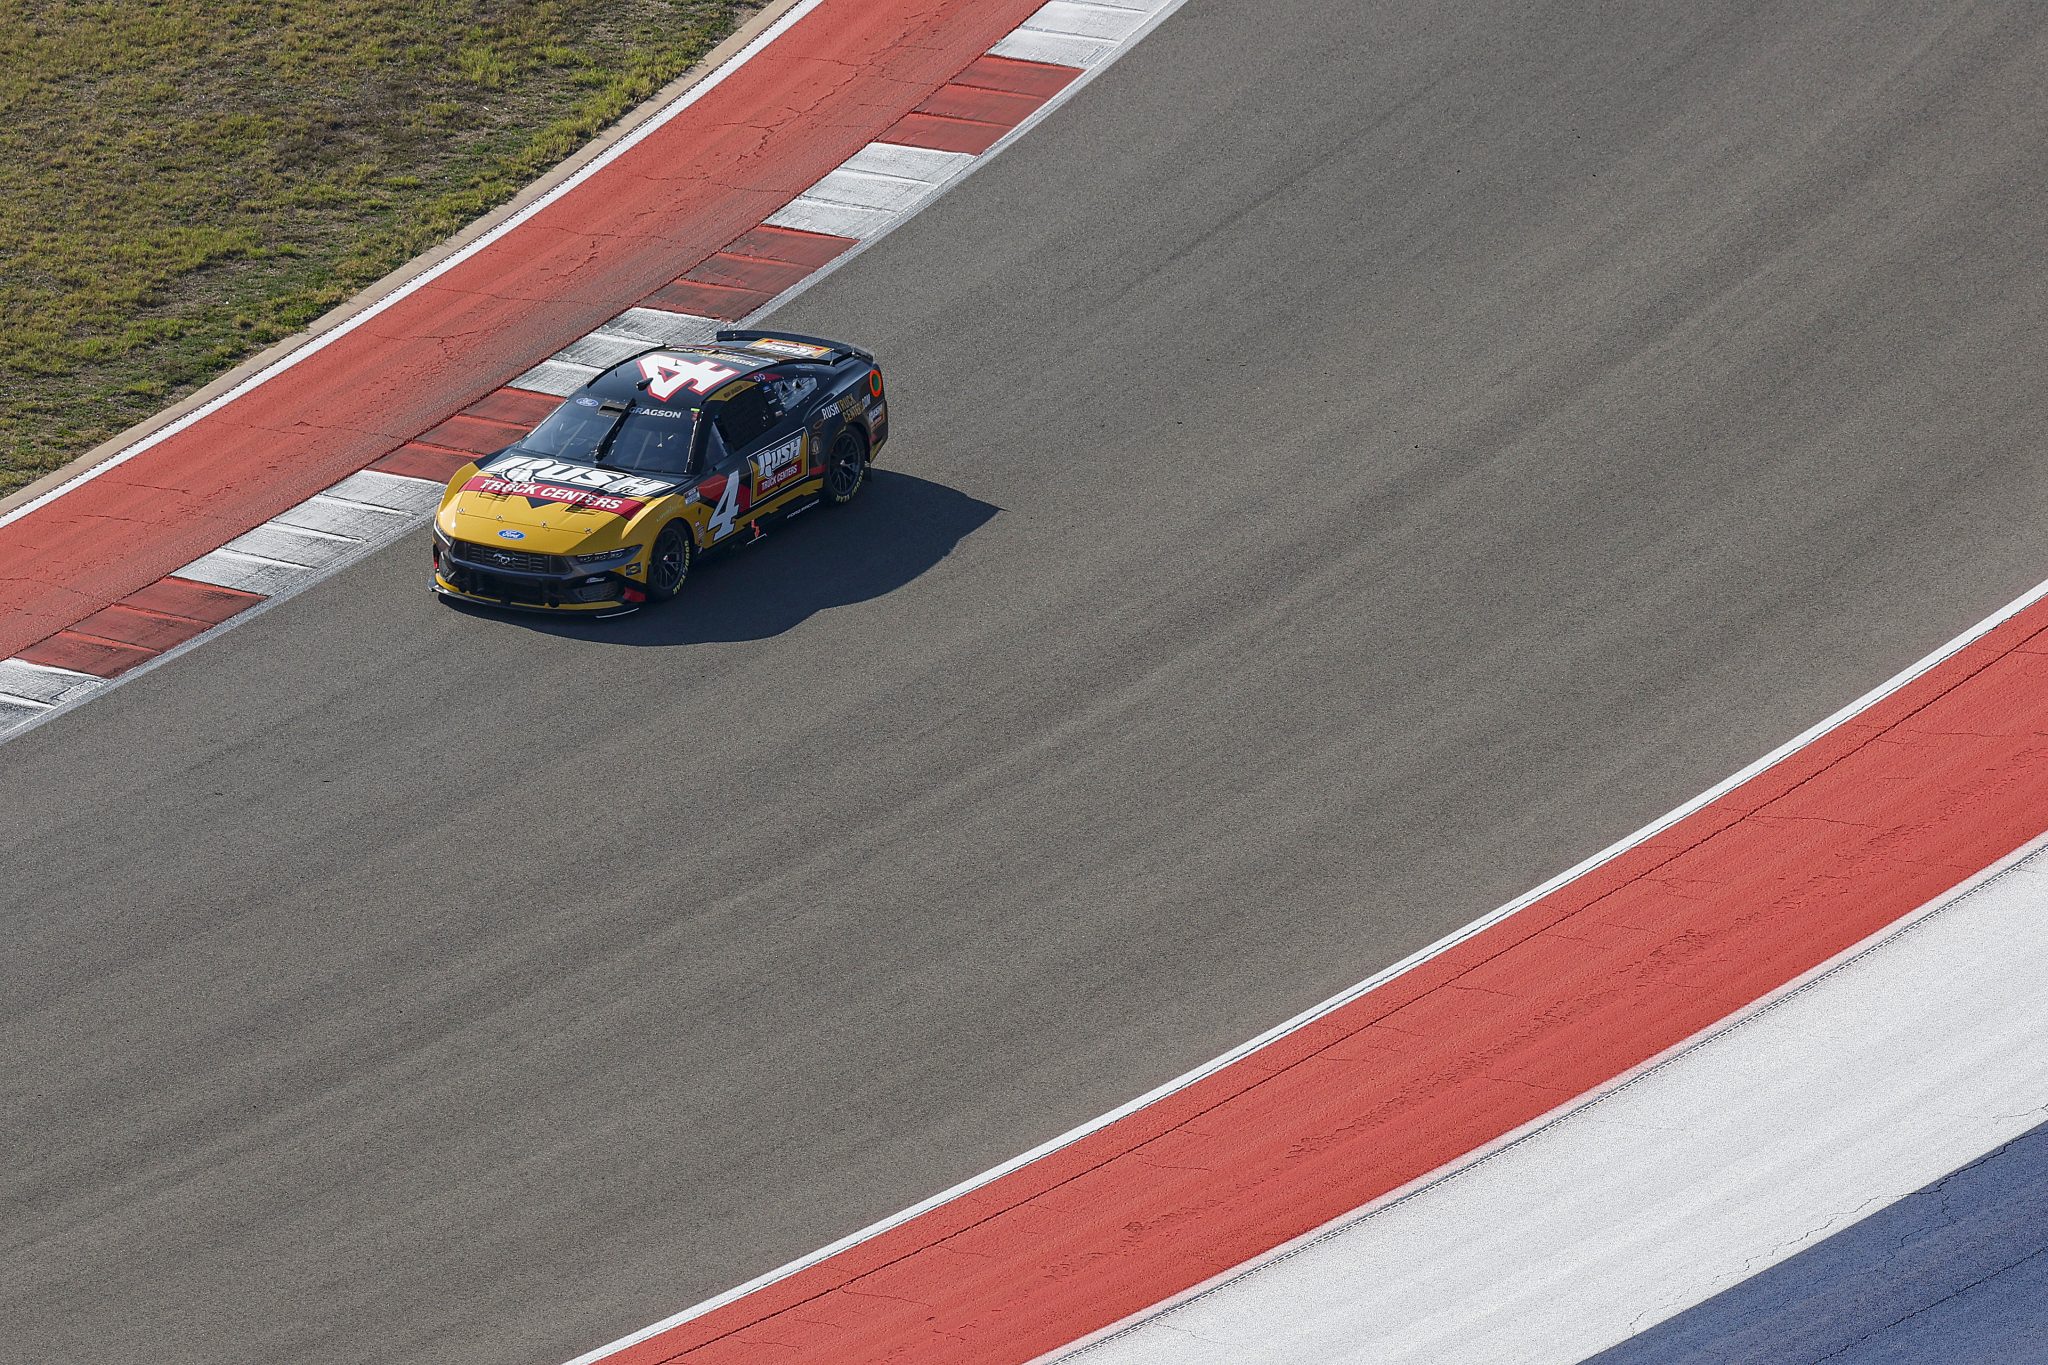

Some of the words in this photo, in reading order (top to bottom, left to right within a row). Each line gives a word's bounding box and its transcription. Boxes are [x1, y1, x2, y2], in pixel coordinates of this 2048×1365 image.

[637, 354, 740, 401] 4
[629, 406, 682, 419] GRAGSON
[757, 435, 801, 478] RUSH
[480, 456, 672, 496] RUSH
[761, 477, 777, 491] TRUCK
[777, 466, 798, 483] CENTERS
[480, 479, 542, 495] TRUCK
[543, 487, 623, 510] CENTERS
[707, 470, 739, 541] 4
[501, 529, 523, 541] Ford
